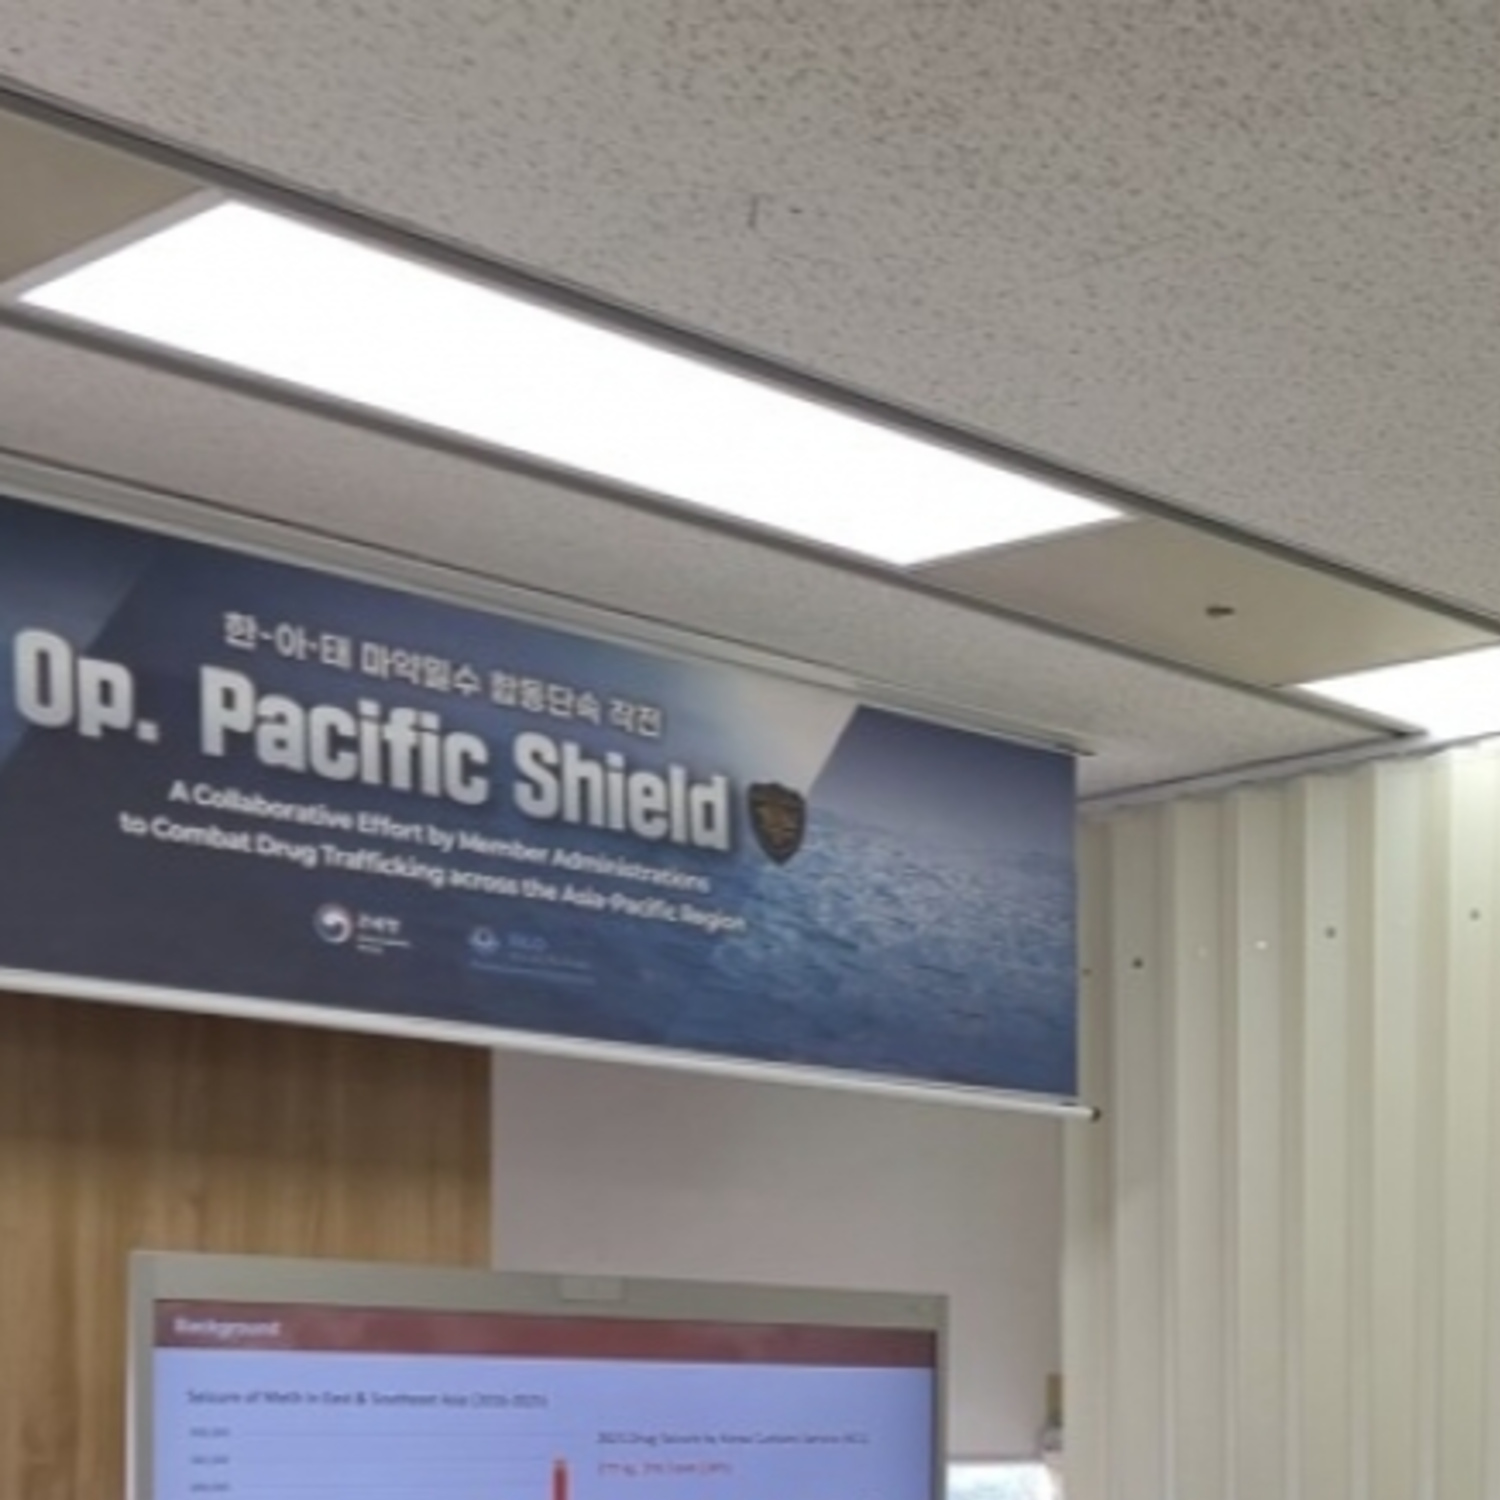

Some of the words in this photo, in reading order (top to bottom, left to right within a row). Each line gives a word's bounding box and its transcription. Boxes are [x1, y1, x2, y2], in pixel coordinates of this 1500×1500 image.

[13, 628, 158, 741] Op.
[200, 664, 489, 805] Pacific
[513, 731, 731, 851] Shield
[361, 640, 481, 697] 마약밀수
[491, 670, 601, 724] 합동단속
[609, 698, 663, 738] 작전
[119, 811, 148, 835] to
[152, 815, 251, 852] Combat
[256, 833, 318, 868] Drug
[321, 844, 445, 888] Trafficking
[451, 868, 518, 896] across
[522, 877, 557, 901] the
[680, 904, 746, 932] Region
[168, 780, 190, 803] A
[192, 783, 352, 829] Collaborative
[357, 811, 424, 843] Effort
[428, 823, 454, 852] by
[458, 831, 548, 862] Member
[552, 850, 711, 894] Administrations
[175, 1317, 281, 1339] Background
